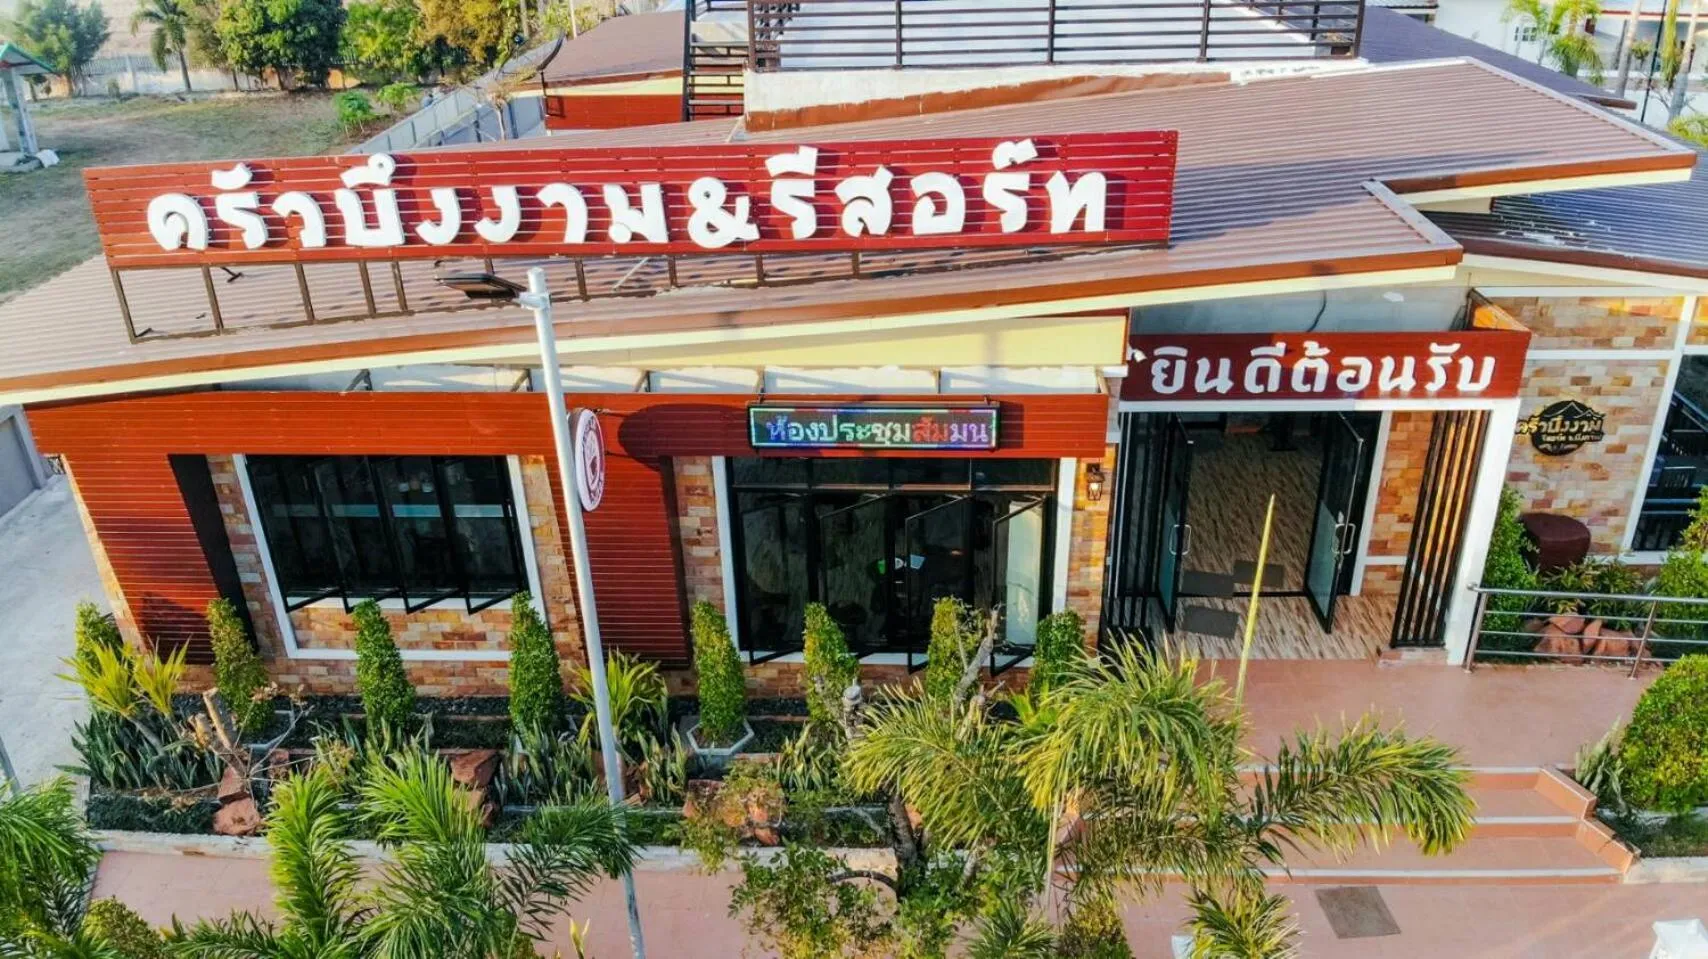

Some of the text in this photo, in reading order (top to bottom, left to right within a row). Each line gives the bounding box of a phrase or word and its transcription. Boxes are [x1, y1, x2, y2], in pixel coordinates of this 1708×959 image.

[1151, 341, 1496, 394] ยินดีต้อนรับ
